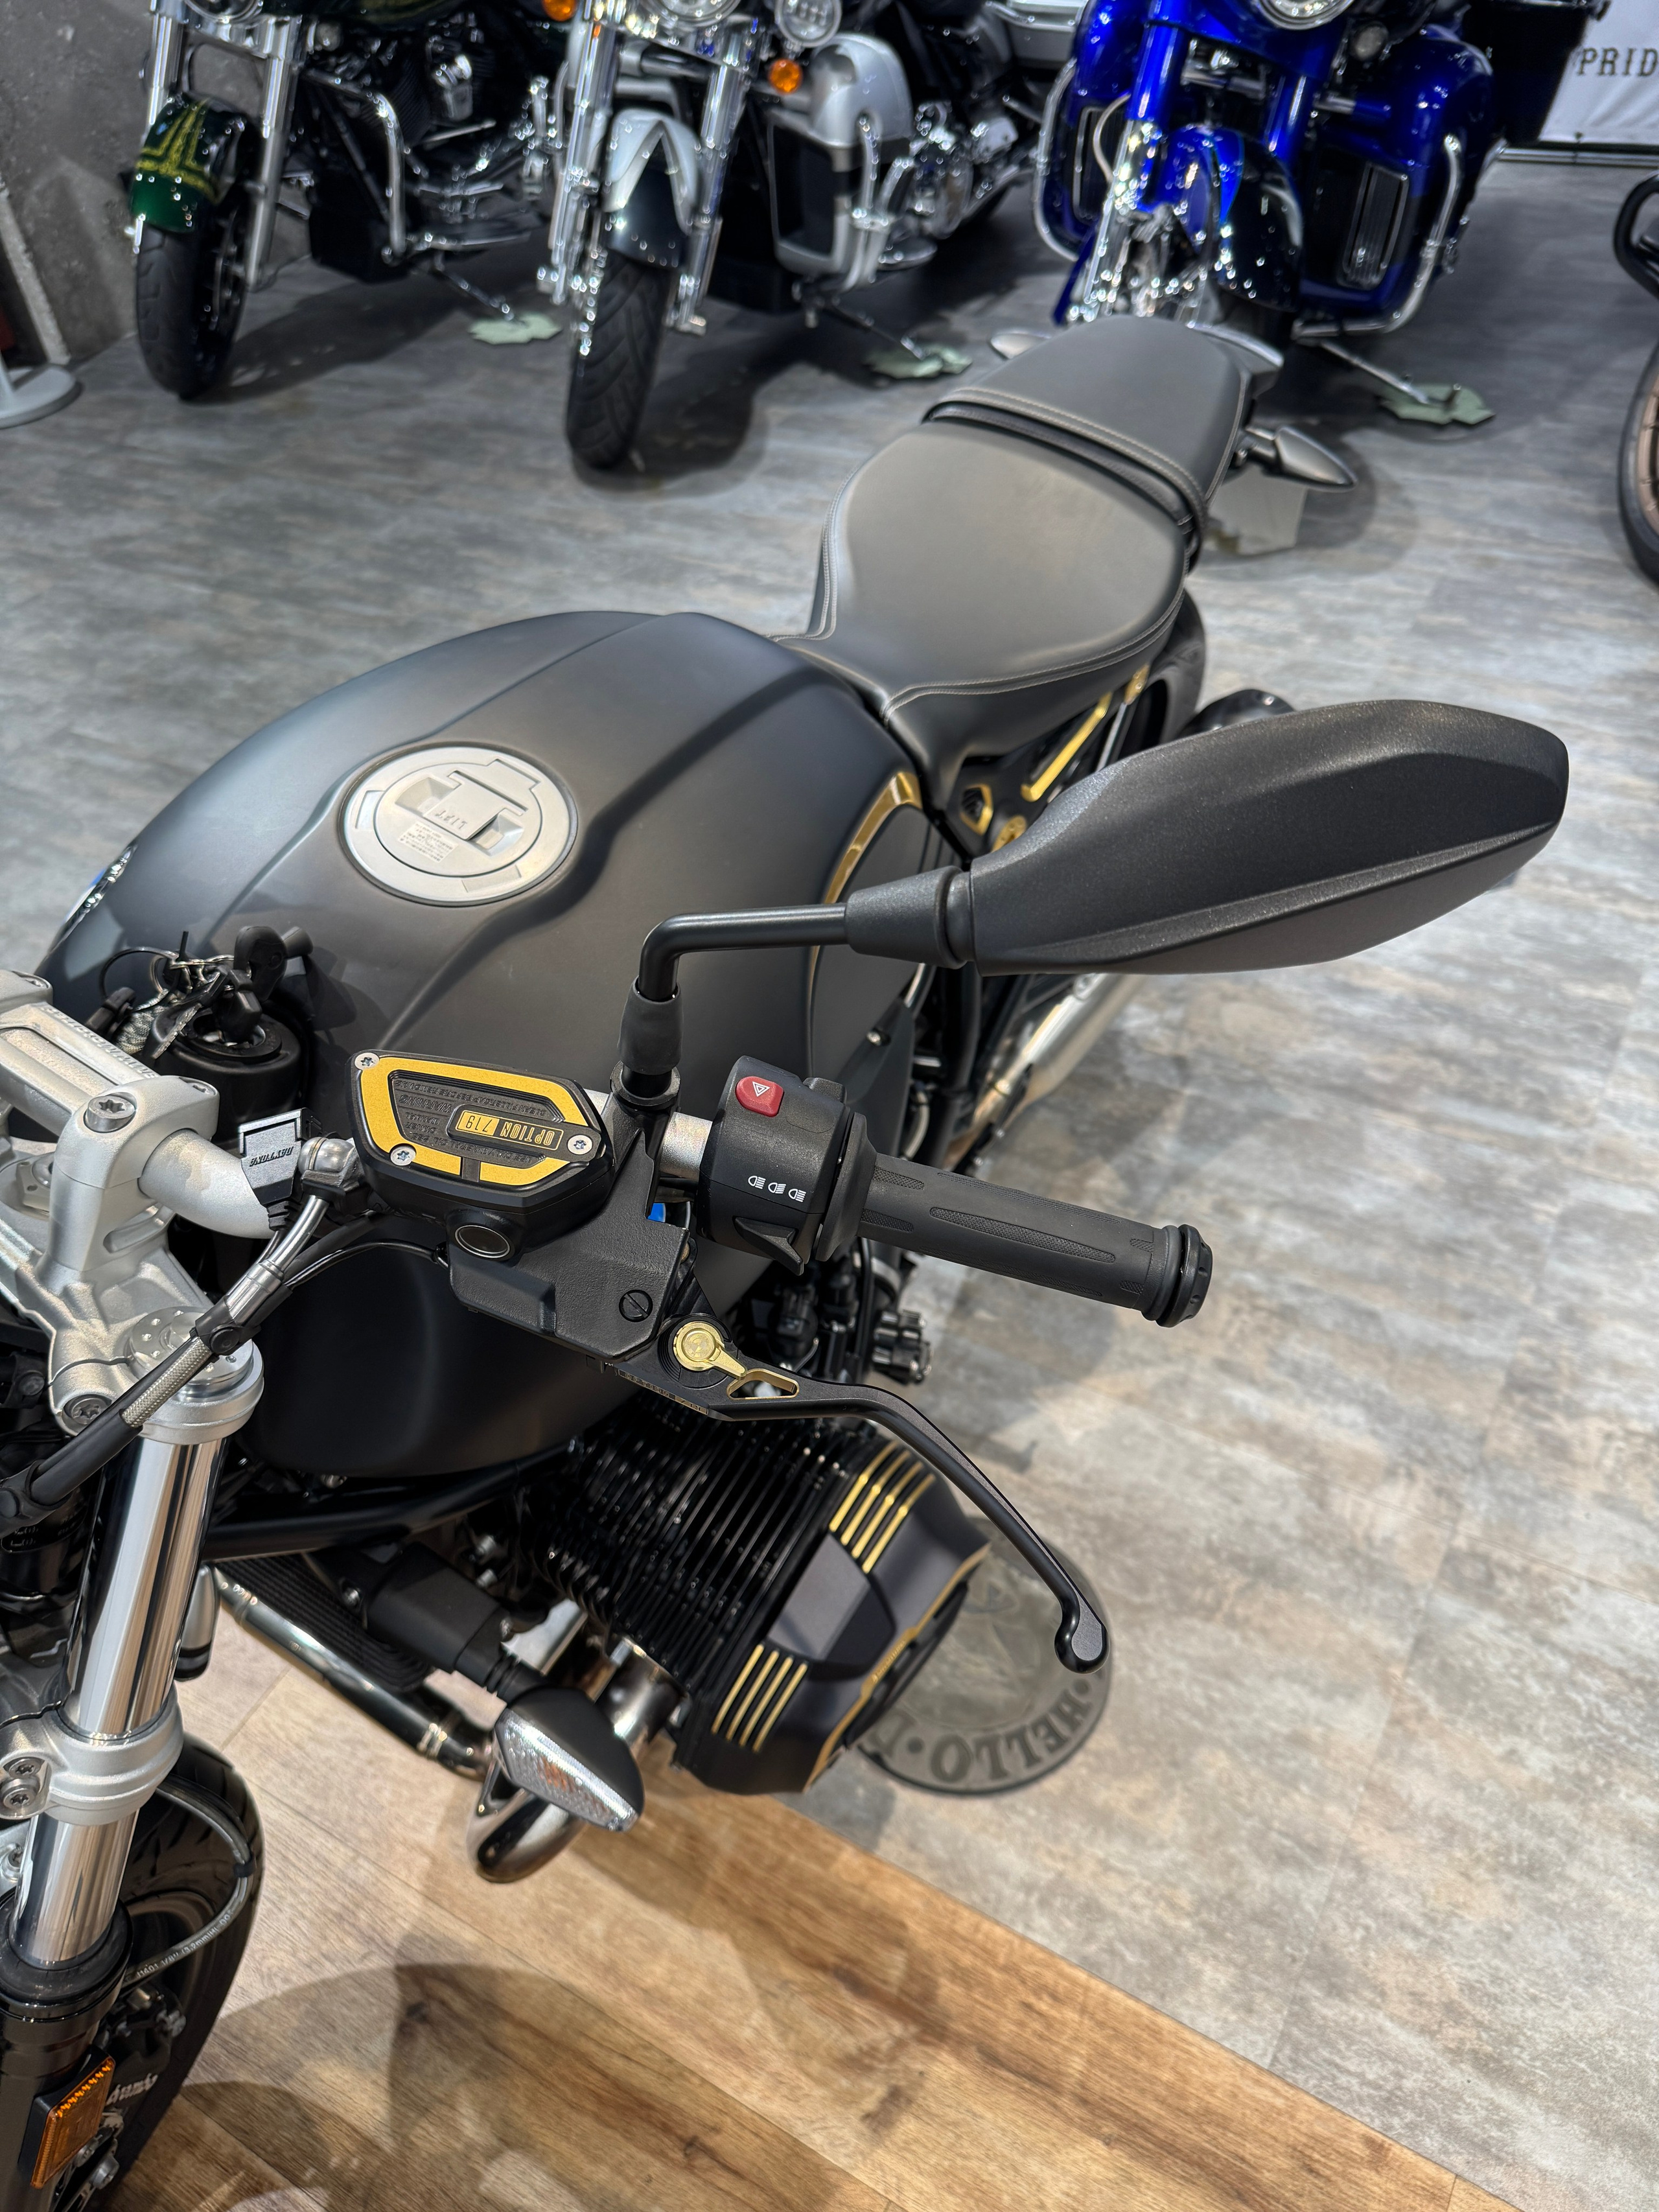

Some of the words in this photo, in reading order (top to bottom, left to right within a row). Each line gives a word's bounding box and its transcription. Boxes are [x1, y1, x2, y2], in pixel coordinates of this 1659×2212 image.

[435, 809, 468, 830] LIFT
[399, 1095, 453, 1113] WARNING
[465, 1115, 493, 1133] 719
[500, 1121, 555, 1146] OPTION
[930, 1689, 1094, 1783] HELLO
